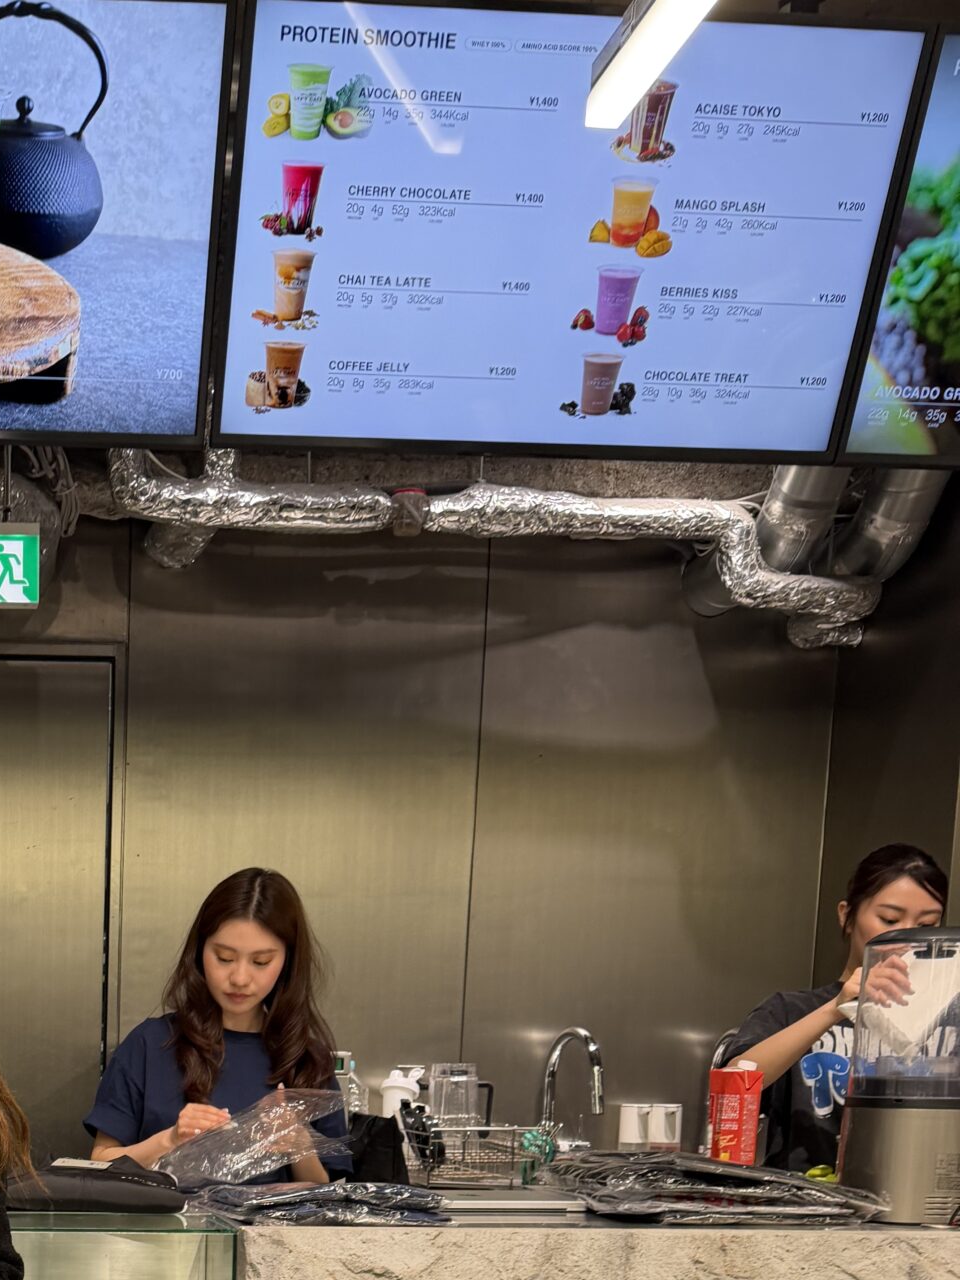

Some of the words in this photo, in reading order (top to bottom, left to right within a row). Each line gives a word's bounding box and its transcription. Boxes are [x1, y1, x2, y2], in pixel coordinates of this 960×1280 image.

[280, 24, 359, 45] PROTEIN
[363, 28, 458, 50] SMOOTHIE
[358, 87, 417, 100] AVOCADO
[420, 89, 462, 102] GREEN
[529, 96, 559, 108] ¥1,400
[382, 106, 399, 120] 14g
[430, 108, 470, 121] 344Kcal
[694, 103, 738, 116] ACAISE
[742, 105, 782, 118] TOKYO
[860, 112, 890, 124] ¥1,200
[691, 121, 711, 135] 20g
[716, 122, 730, 136] 9g
[737, 123, 755, 136] 27g
[763, 124, 801, 137] 245Kcal
[348, 184, 397, 198] CHERRY
[400, 187, 472, 201] CHOCOLATE
[515, 193, 544, 204] ¥1,400
[346, 203, 365, 216] 20g
[371, 204, 384, 217] 4g
[391, 205, 410, 218] 52g
[418, 205, 456, 217] 323Kcal
[674, 198, 718, 211] MANGO
[721, 200, 766, 213] SPLASH
[837, 201, 866, 213] ¥1,200
[671, 216, 689, 229] 21g
[695, 216, 708, 230] 2g
[715, 218, 733, 231] 42g
[741, 219, 778, 231] 260Kcal
[338, 274, 366, 286] CHAI
[370, 275, 392, 287] TEA
[395, 276, 432, 288] LATTE
[502, 281, 530, 292] ¥1,400
[336, 291, 355, 304] 20g
[361, 292, 373, 305] 5g
[659, 286, 709, 298] BERRIES
[712, 287, 739, 299] KISS
[819, 293, 847, 304] ¥1,200
[683, 304, 695, 317] 5g
[702, 304, 720, 317] 22g
[726, 305, 763, 317] 227Kcal
[328, 360, 374, 372] COFFEE
[376, 362, 410, 373] JELLY
[489, 366, 517, 377] ¥1,200
[327, 376, 345, 389] 20g
[352, 377, 365, 390] 8g
[373, 378, 392, 391] 35g
[644, 370, 711, 383] CHOCOLATE
[714, 372, 749, 384] TREAT
[799, 376, 828, 388] ¥1,200
[641, 386, 660, 399] 28g
[667, 386, 683, 399] 10g
[875, 385, 940, 400] AVOCADO
[925, 408, 948, 424] 35g
